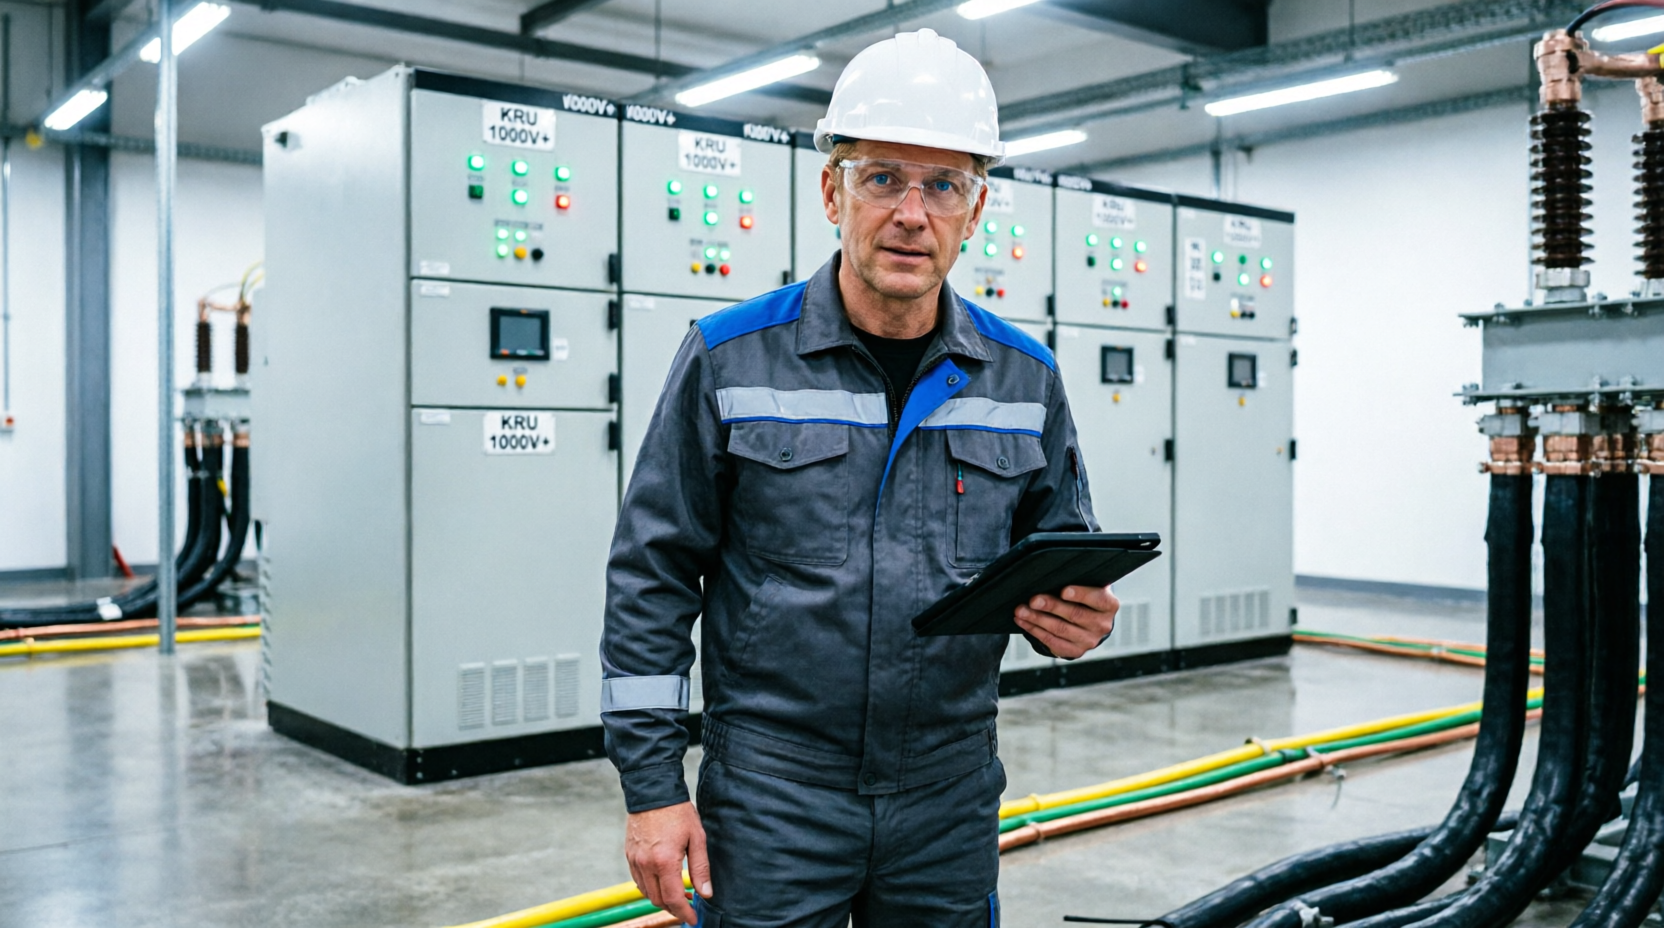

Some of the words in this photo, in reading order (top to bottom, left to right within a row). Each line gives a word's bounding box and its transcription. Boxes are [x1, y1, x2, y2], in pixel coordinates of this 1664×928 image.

[500, 107, 538, 126] KRU
[489, 124, 550, 144] 1000V+
[695, 137, 726, 153] KRU
[501, 415, 538, 430] KRU
[489, 434, 550, 450] 1000V+
